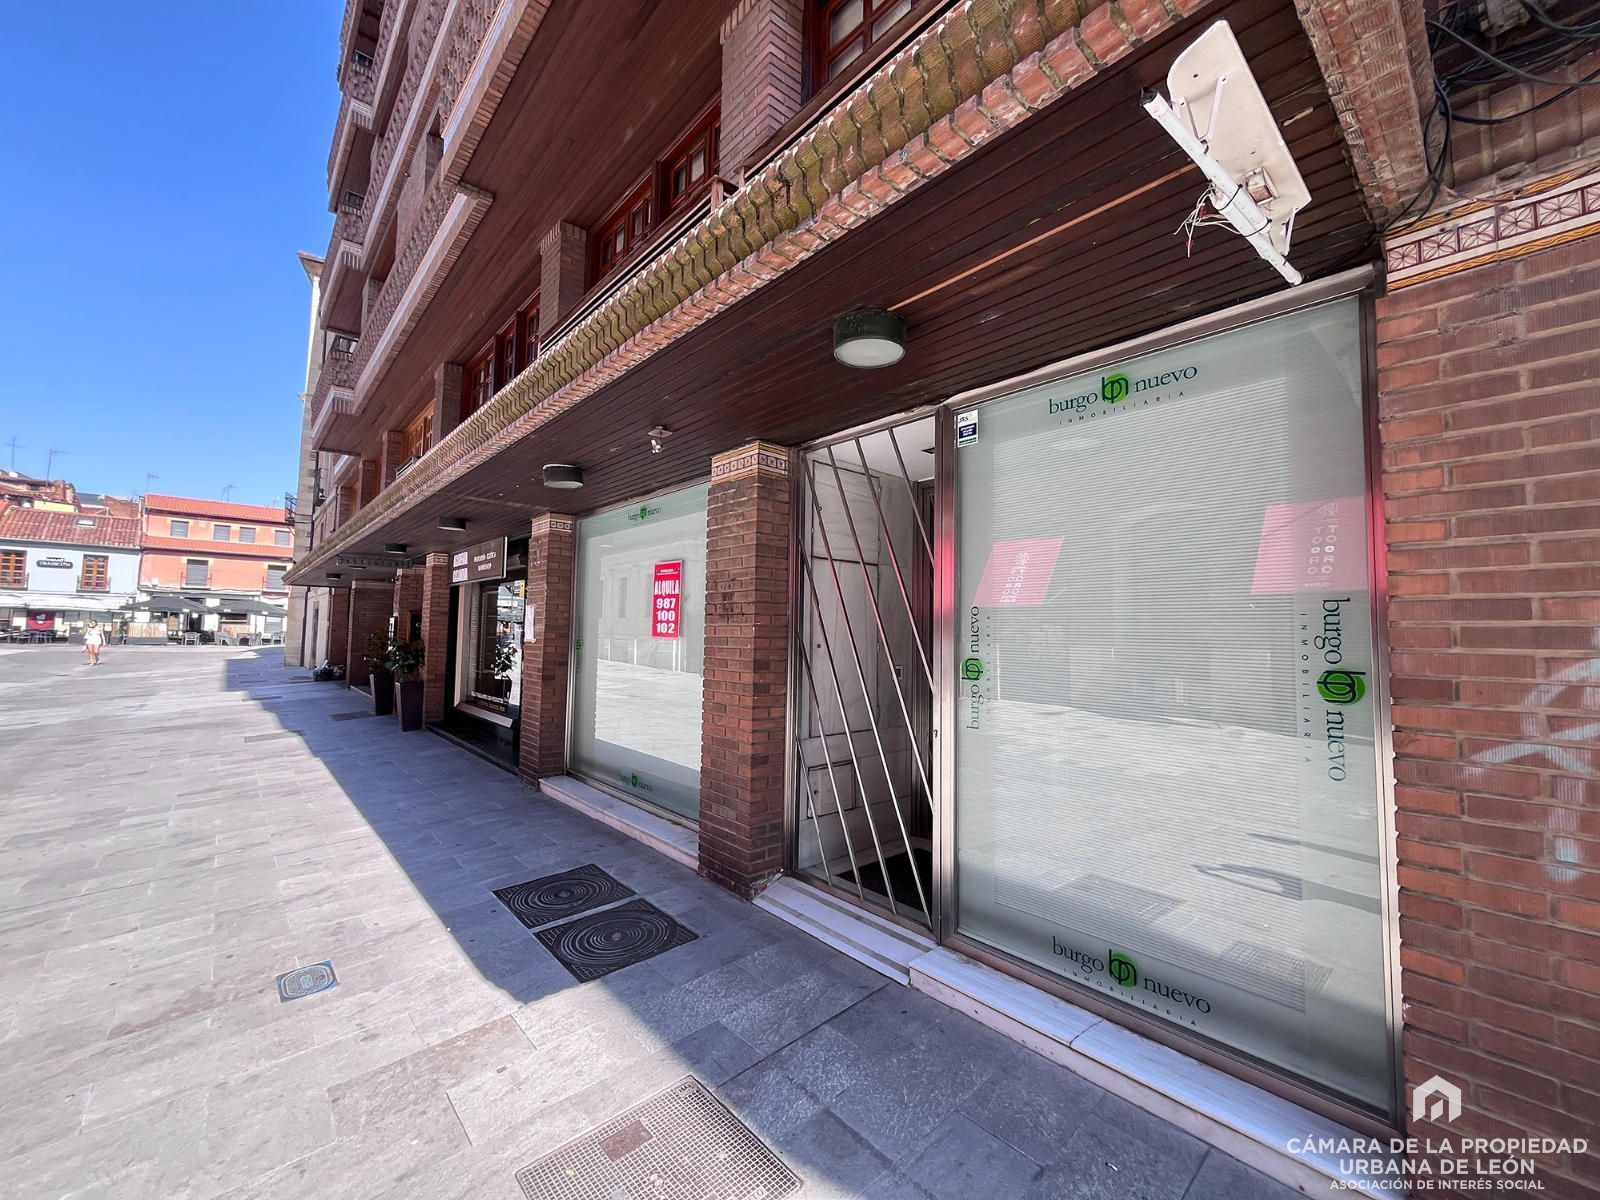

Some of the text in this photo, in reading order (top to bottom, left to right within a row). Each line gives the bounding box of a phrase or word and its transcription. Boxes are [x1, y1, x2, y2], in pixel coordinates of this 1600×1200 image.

[1049, 391, 1098, 415] burgo
[1134, 366, 1198, 393] nuevo
[654, 580, 679, 596] ALQUILA
[656, 598, 676, 609] 987
[656, 610, 676, 621] 100
[656, 622, 675, 633] 102
[970, 606, 980, 653] nuevo
[1314, 597, 1351, 665] burgo
[966, 684, 985, 730] burgo
[1326, 709, 1347, 782] nuevo
[1052, 936, 1105, 974] burgo
[1144, 977, 1212, 1014] nuevo
